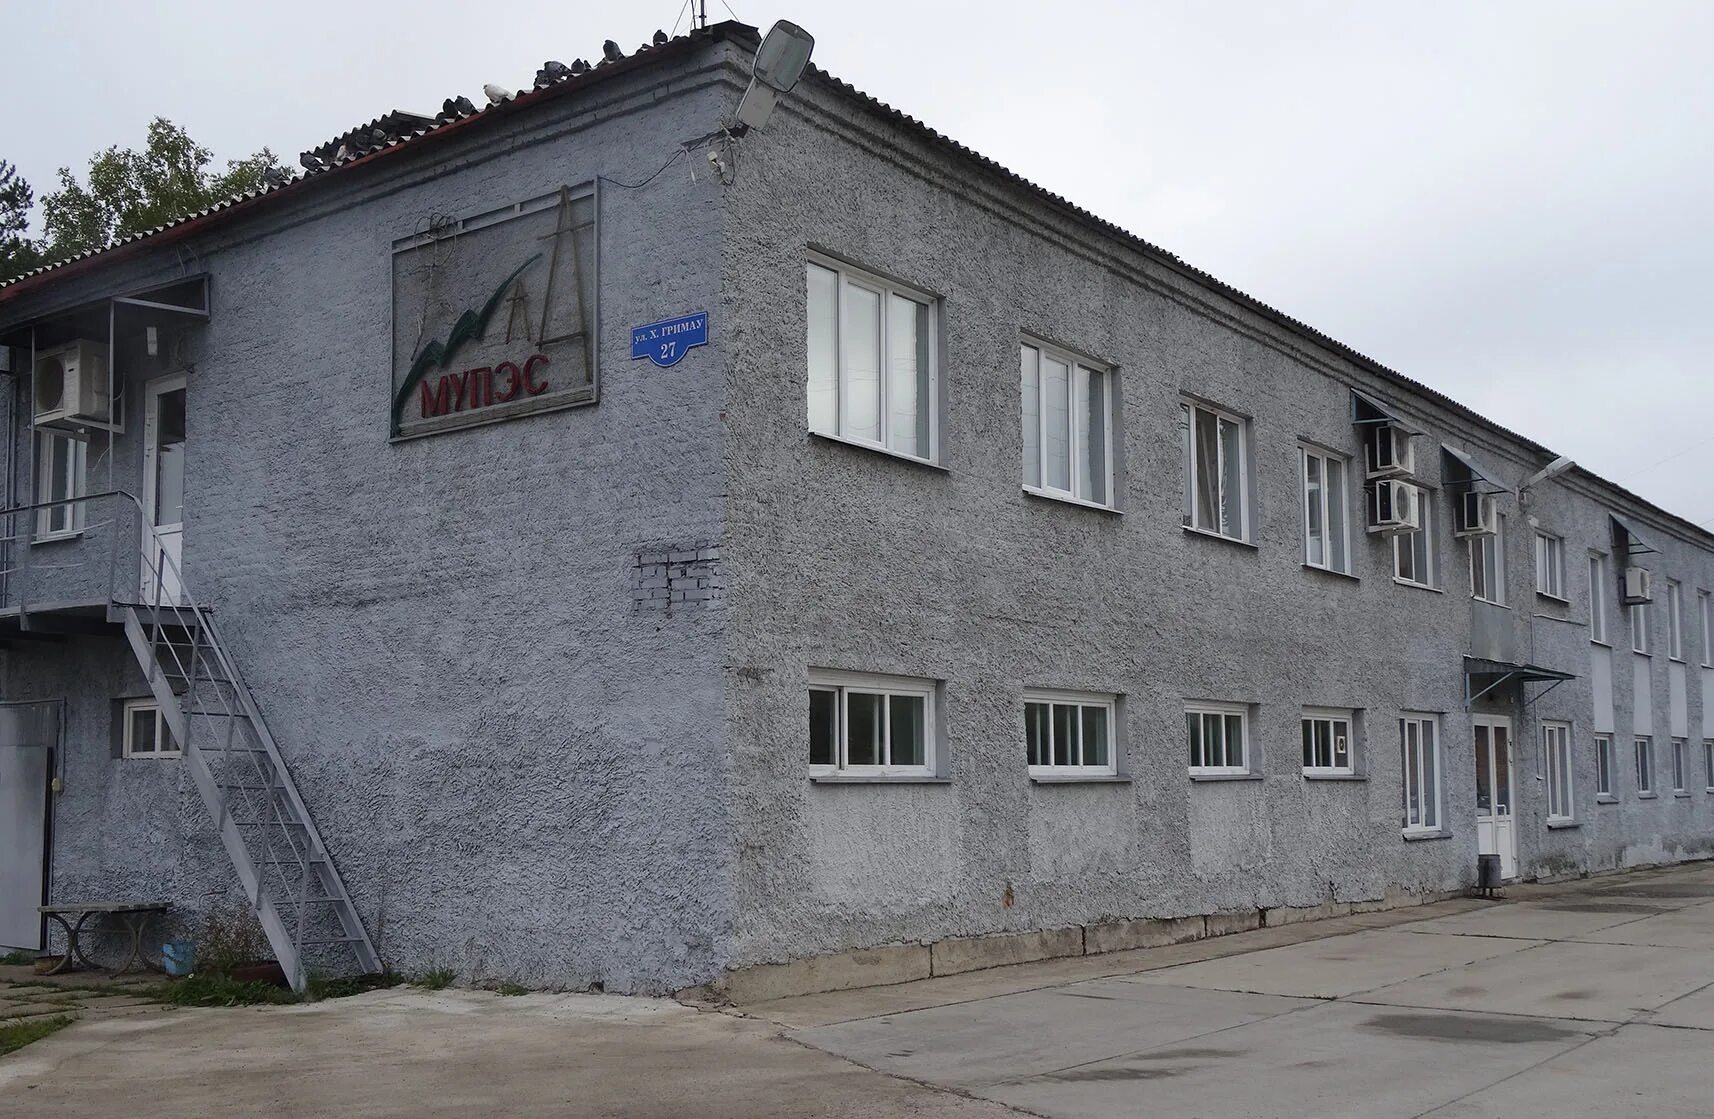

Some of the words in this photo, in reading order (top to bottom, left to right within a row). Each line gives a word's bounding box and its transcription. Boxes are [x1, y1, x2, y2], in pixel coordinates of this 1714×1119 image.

[635, 334, 648, 345] ул.
[650, 329, 659, 339] Х.
[661, 319, 704, 337] ГРИМАУ
[660, 341, 676, 359] 27
[421, 354, 549, 418] МУПЭС
